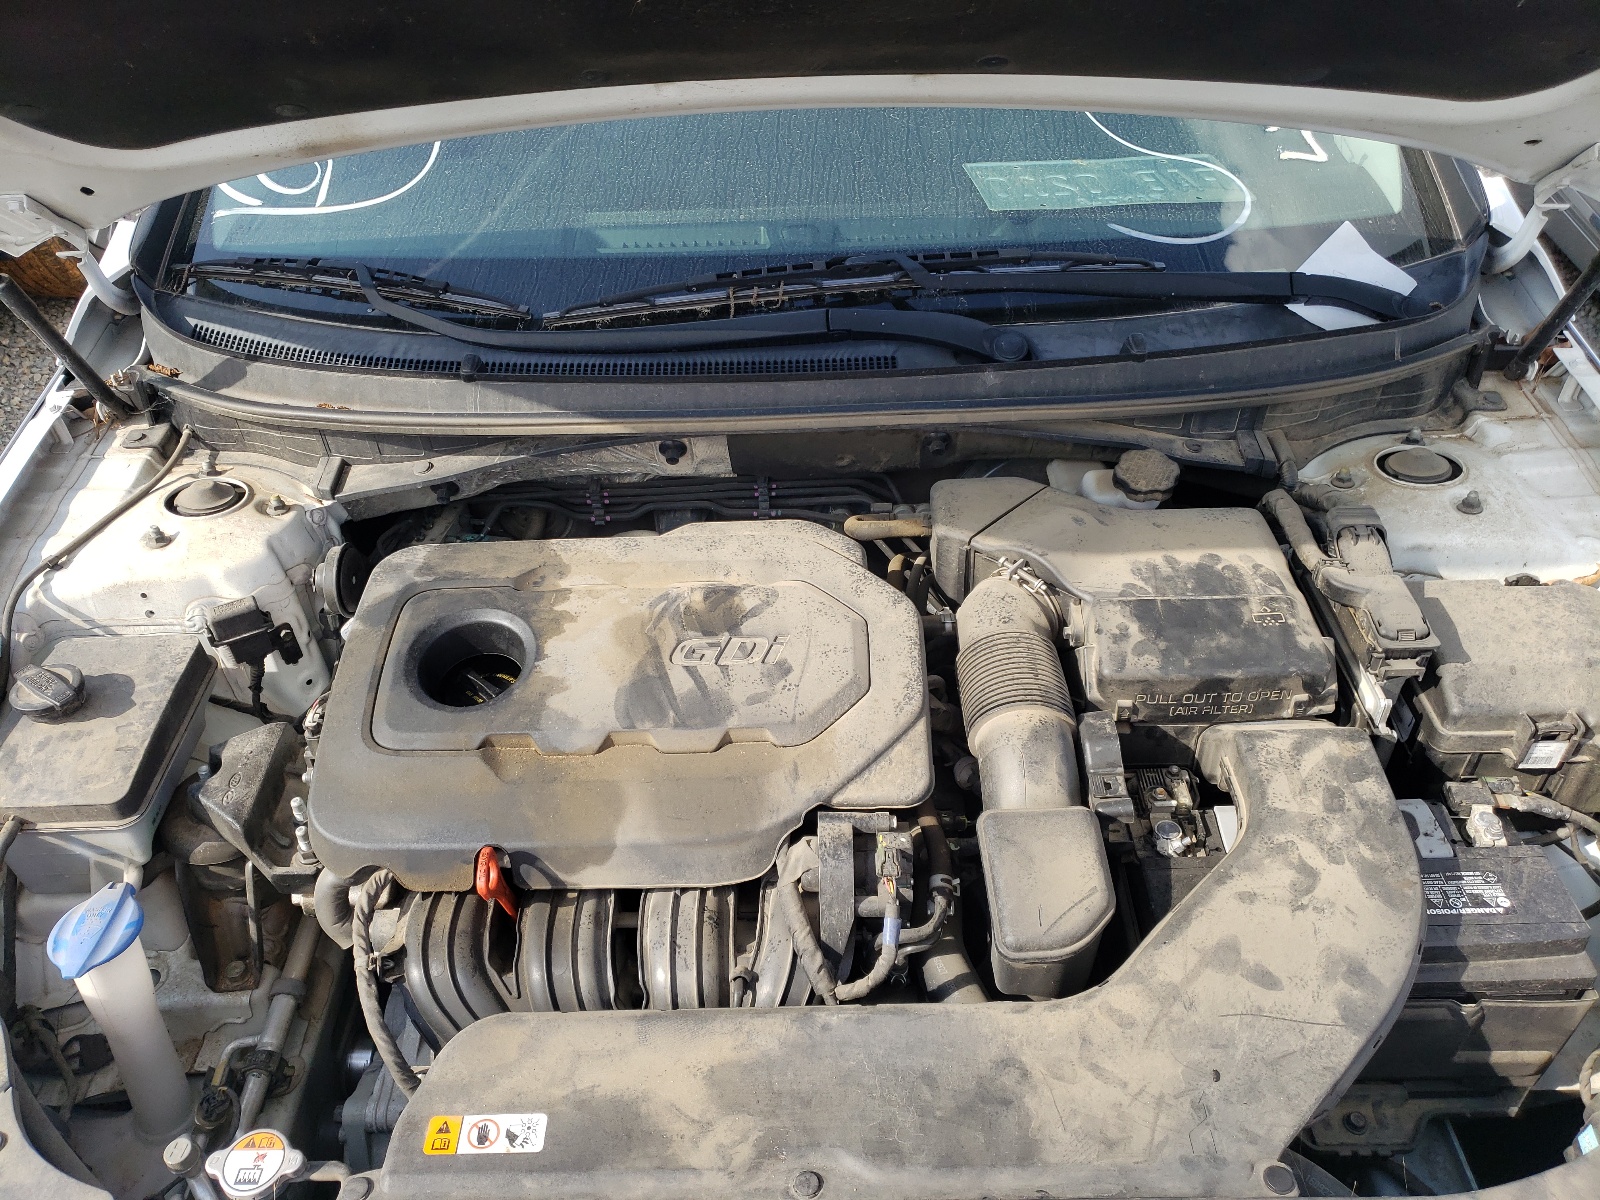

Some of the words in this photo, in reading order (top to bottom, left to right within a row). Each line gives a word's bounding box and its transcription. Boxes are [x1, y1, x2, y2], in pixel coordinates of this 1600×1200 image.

[1135, 694, 1178, 704] PULL
[1182, 693, 1218, 704] OUT
[1221, 692, 1243, 702] TO
[1247, 690, 1294, 701] OPEN
